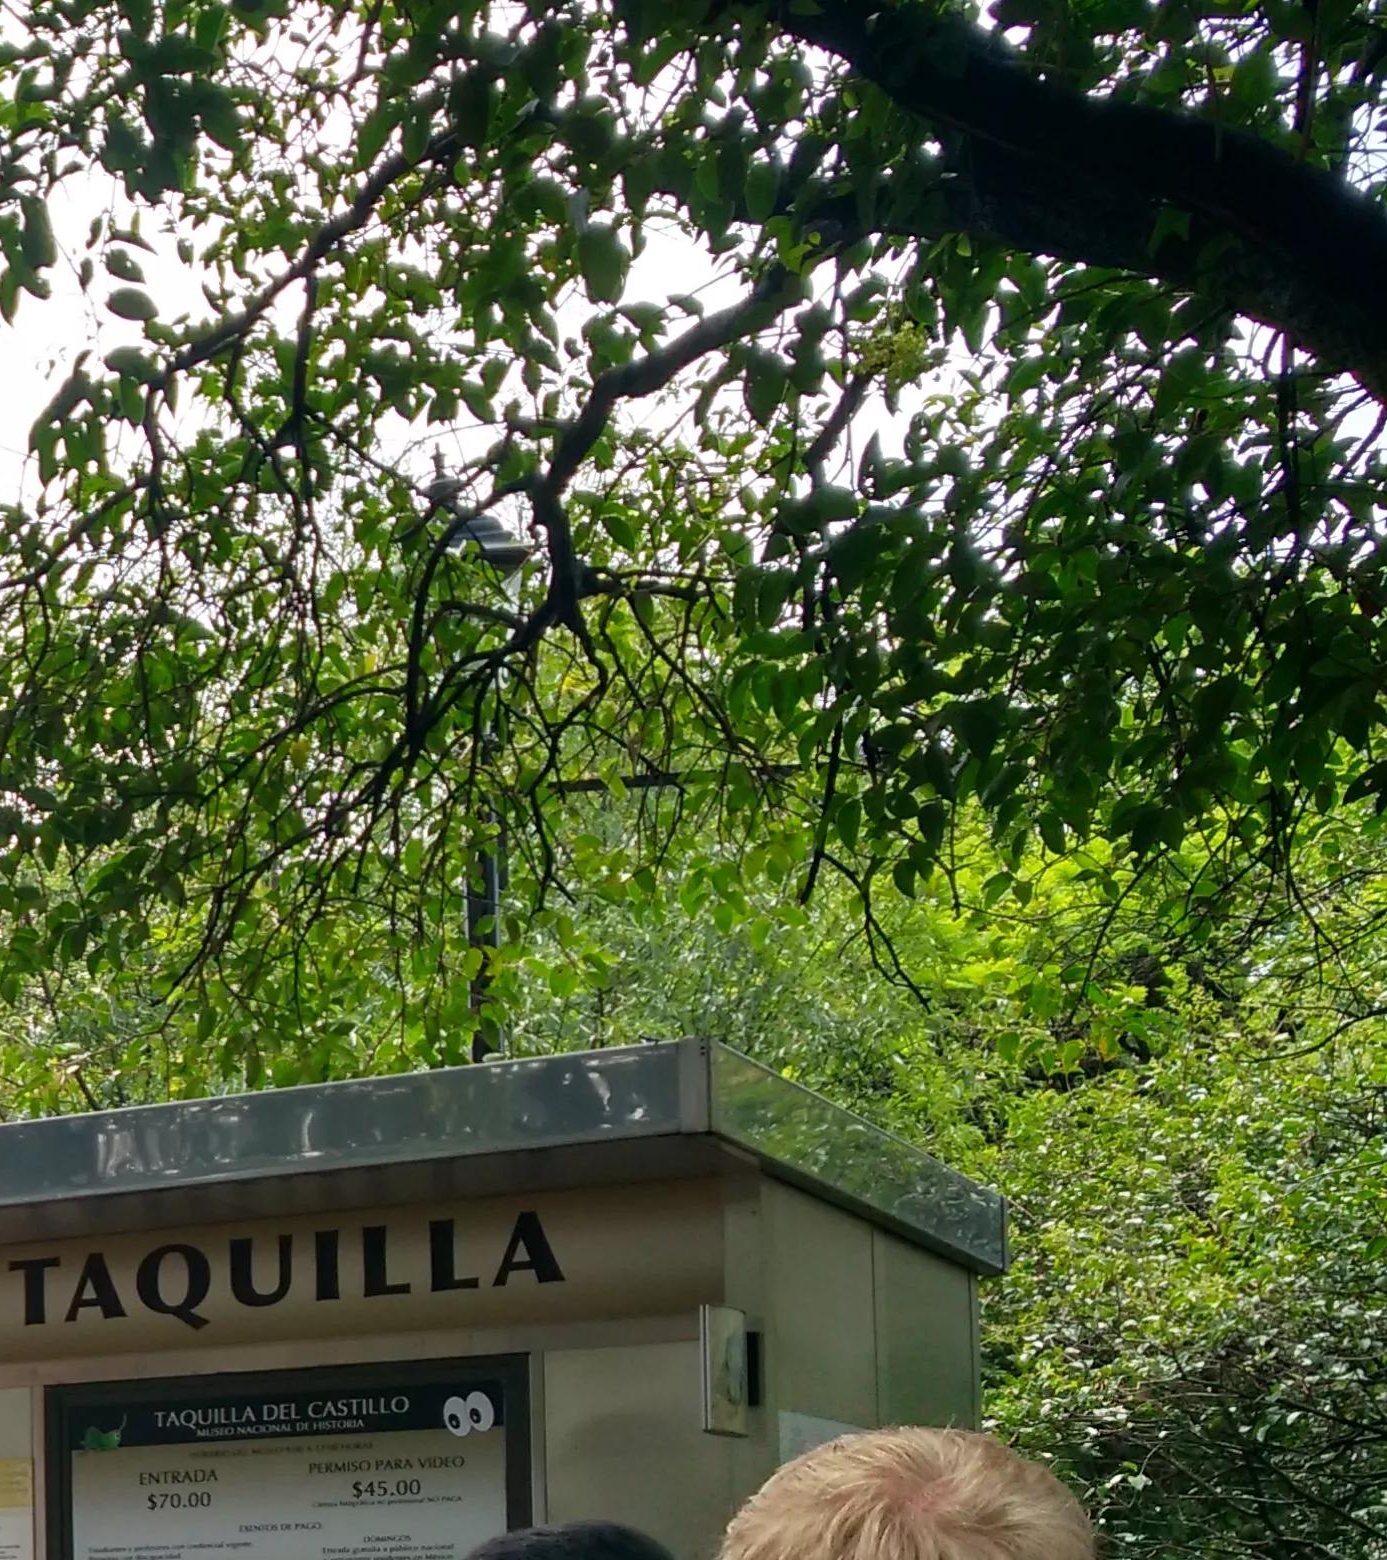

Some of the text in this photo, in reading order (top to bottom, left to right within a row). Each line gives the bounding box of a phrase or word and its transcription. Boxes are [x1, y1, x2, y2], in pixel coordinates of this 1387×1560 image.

[8, 1211, 565, 1330] TAQUILLA
[153, 1395, 411, 1430] TAQUILLA DEL CASTILLO
[195, 1417, 365, 1439] MUSEO NACIONAL DE HISTORIA
[307, 1454, 466, 1475] PERMISO PARA VIDEO
[138, 1468, 219, 1486] ENTRADA
[351, 1478, 422, 1500] $45.00
[146, 1491, 212, 1512] $70.00
[279, 1523, 292, 1532] DE
[363, 1534, 412, 1543] DOMINGOS
